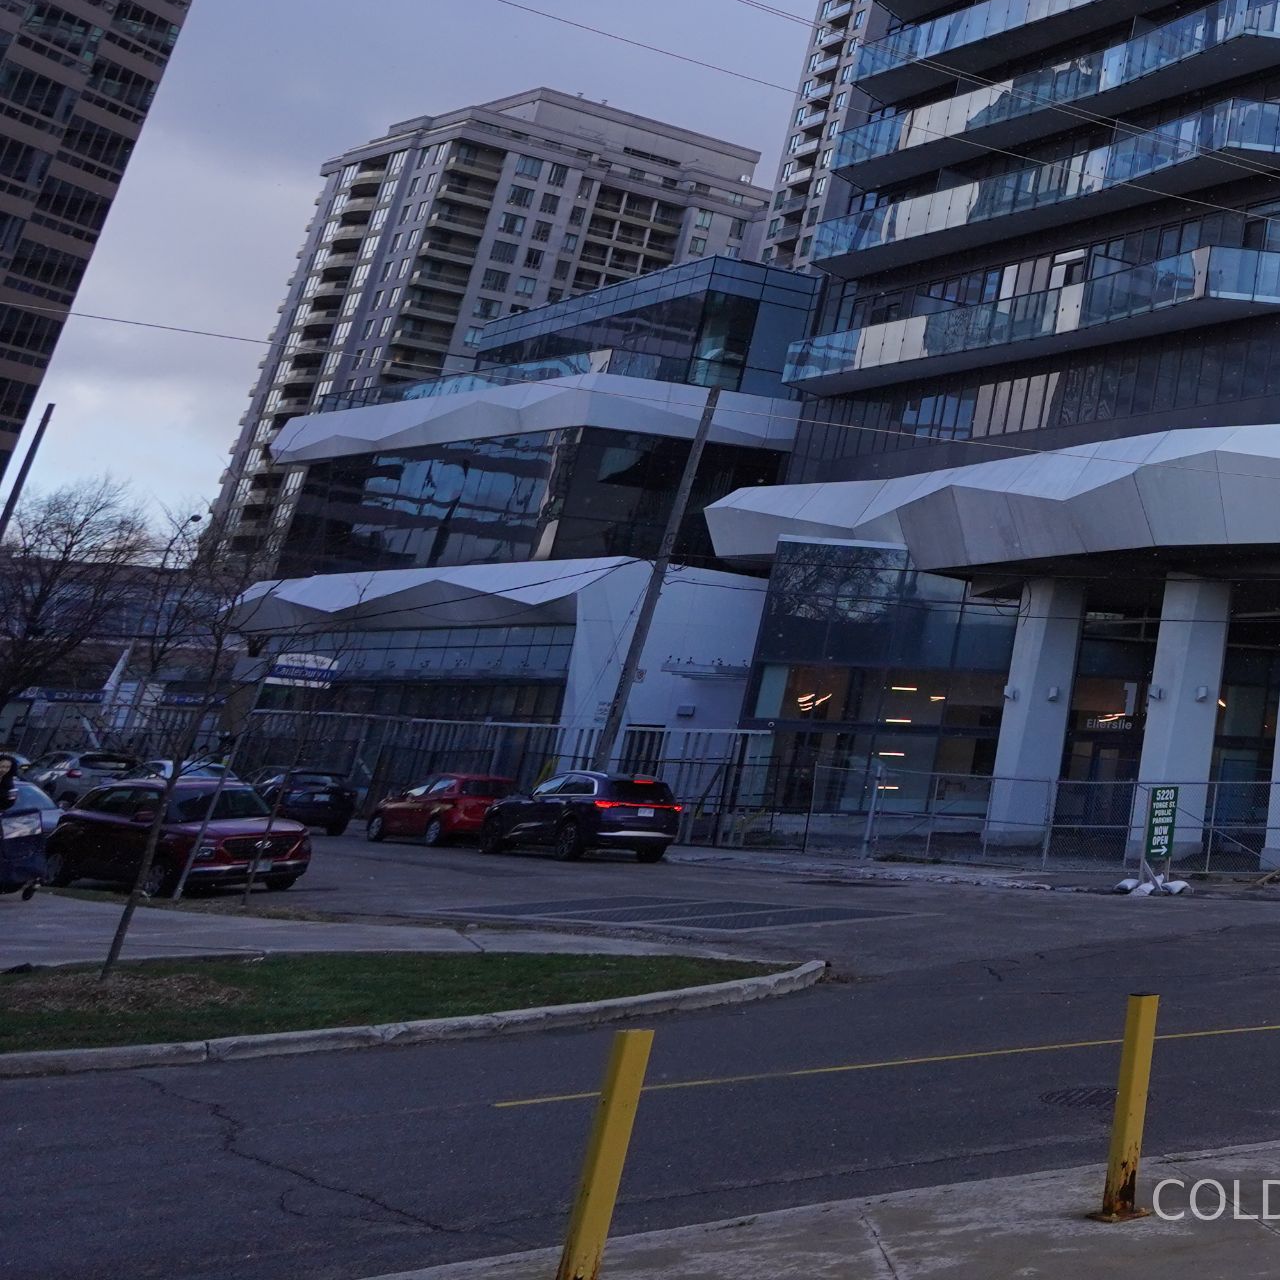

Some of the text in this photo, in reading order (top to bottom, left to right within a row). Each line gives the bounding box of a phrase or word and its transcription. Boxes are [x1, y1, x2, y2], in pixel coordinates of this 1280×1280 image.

[1086, 719, 1133, 730] Ellerslie
[1156, 789, 1175, 801] 5220
[1154, 809, 1172, 817] PUBLIC
[1152, 816, 1173, 824] PARKING
[1154, 825, 1169, 836] NOW
[1152, 836, 1169, 846] OPEN
